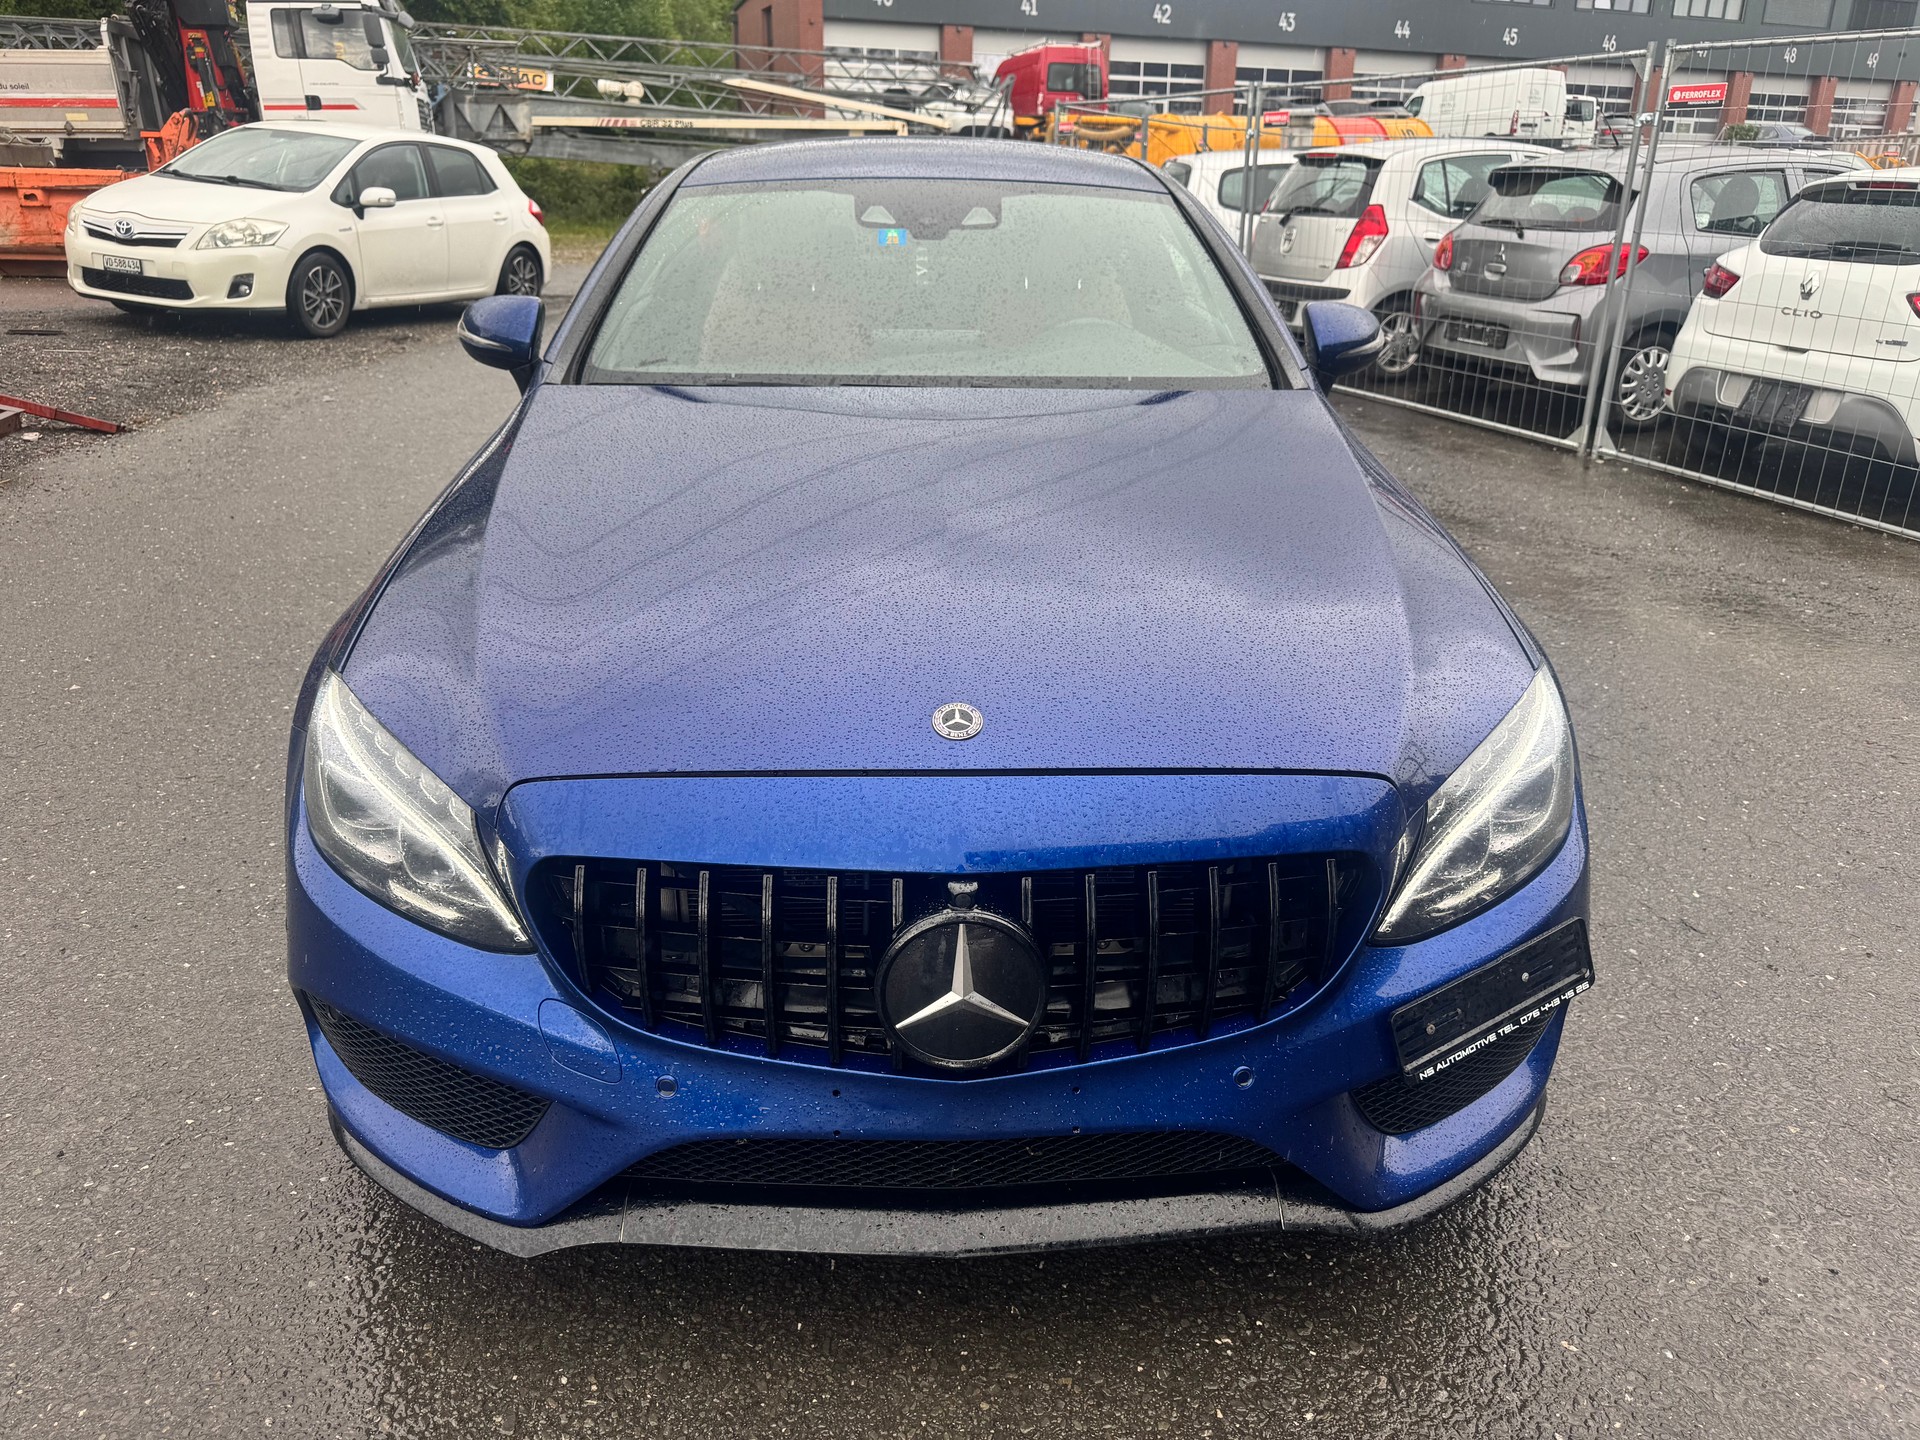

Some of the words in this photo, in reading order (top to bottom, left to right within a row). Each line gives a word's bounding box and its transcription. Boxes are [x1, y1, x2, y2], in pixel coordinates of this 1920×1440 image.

[1020, 0, 1039, 16] 41
[1152, 3, 1172, 24] 42
[1278, 12, 1297, 32] 43
[1394, 20, 1411, 39] 44
[1502, 27, 1519, 46] 45
[1602, 34, 1617, 52] 46
[1783, 47, 1798, 64] 48
[1866, 52, 1880, 69] 49
[10, 82, 30, 90] soleil
[1681, 89, 1722, 99] FERROFLEX
[1781, 307, 1823, 319] CLIO
[1419, 1066, 1435, 1080] NS
[1436, 1032, 1497, 1072] AUTOMOTIVE
[1520, 1008, 1540, 1025] 076
[1541, 997, 1560, 1011] 443
[1561, 989, 1575, 1000] 45
